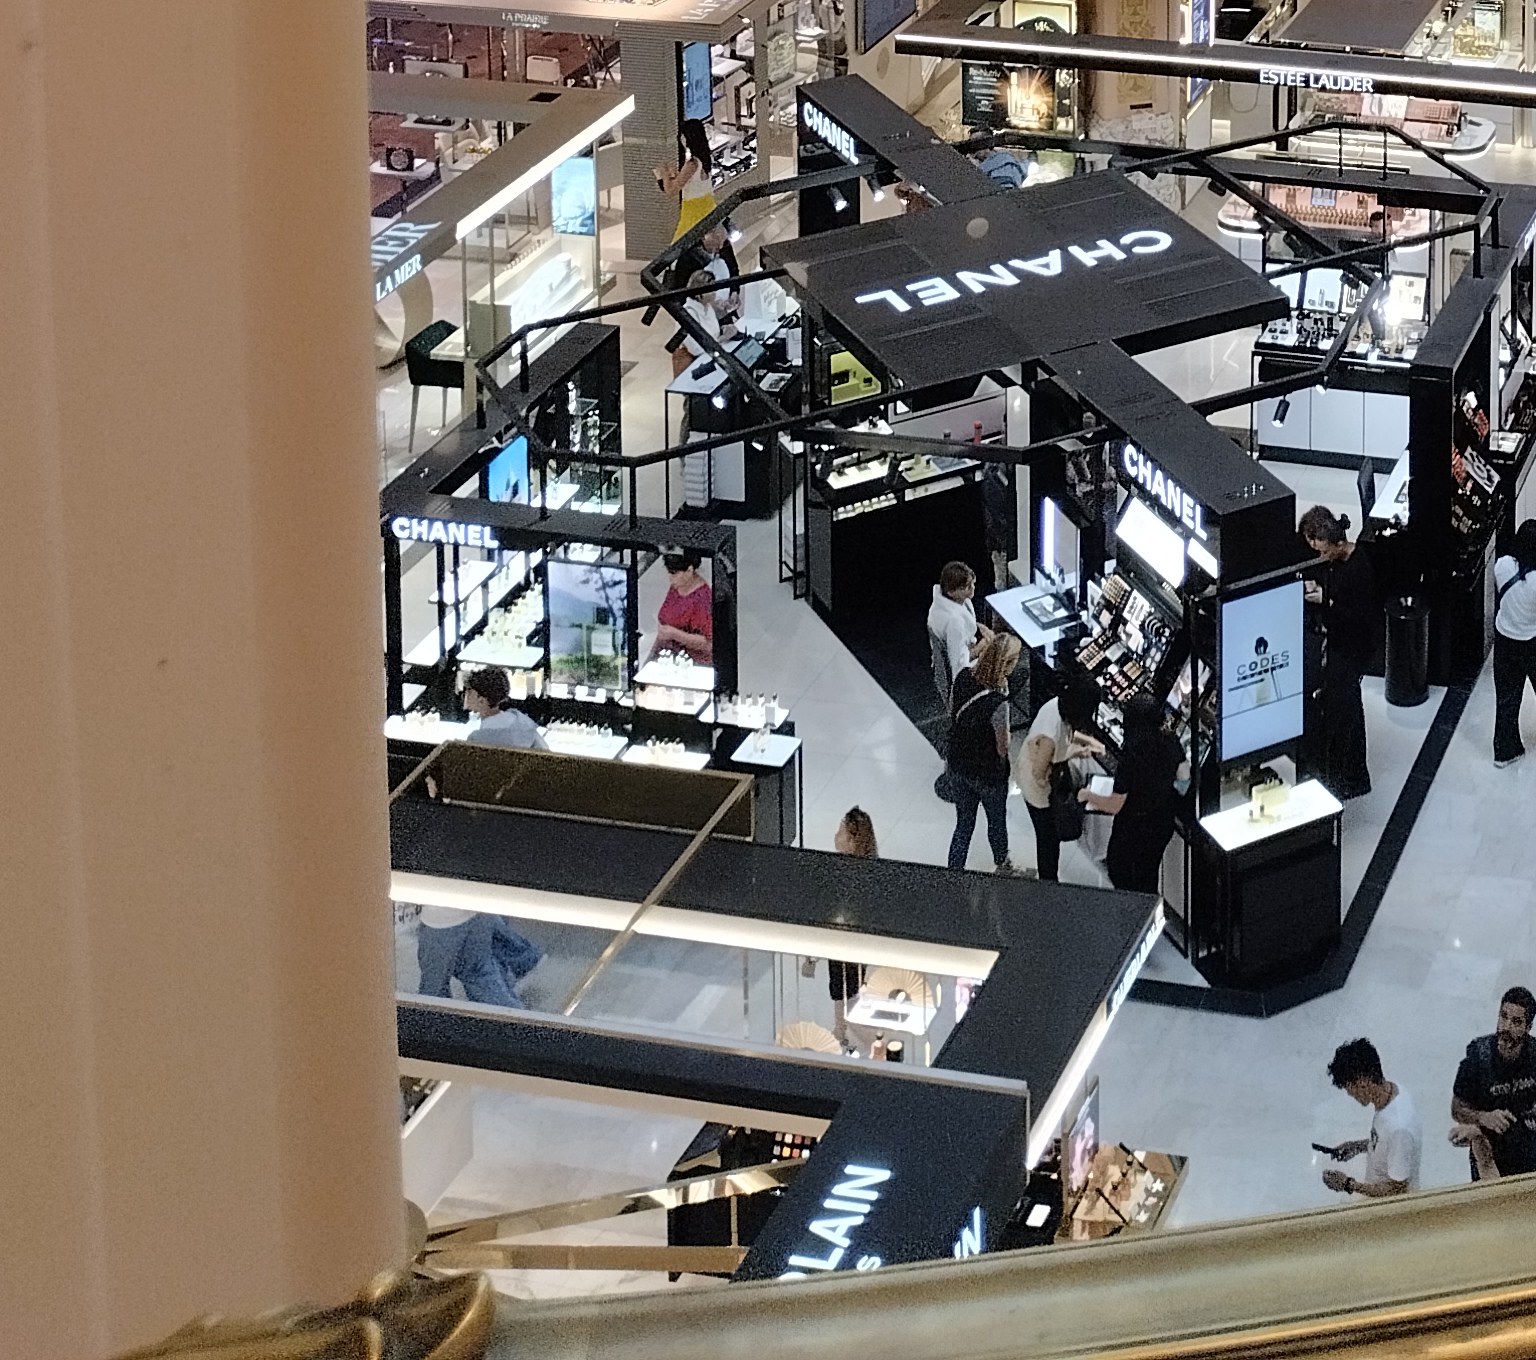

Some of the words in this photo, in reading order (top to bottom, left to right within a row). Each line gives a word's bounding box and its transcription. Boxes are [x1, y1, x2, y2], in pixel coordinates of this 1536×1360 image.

[1309, 73, 1374, 92] LAUDER
[804, 102, 859, 166] CHANEL
[376, 275, 394, 302] LA
[394, 253, 422, 289] MER
[855, 231, 1173, 313] CHANEL
[1124, 443, 1207, 541] CHANEL
[391, 516, 499, 549] CHANEL
[1237, 650, 1290, 675] CODES
